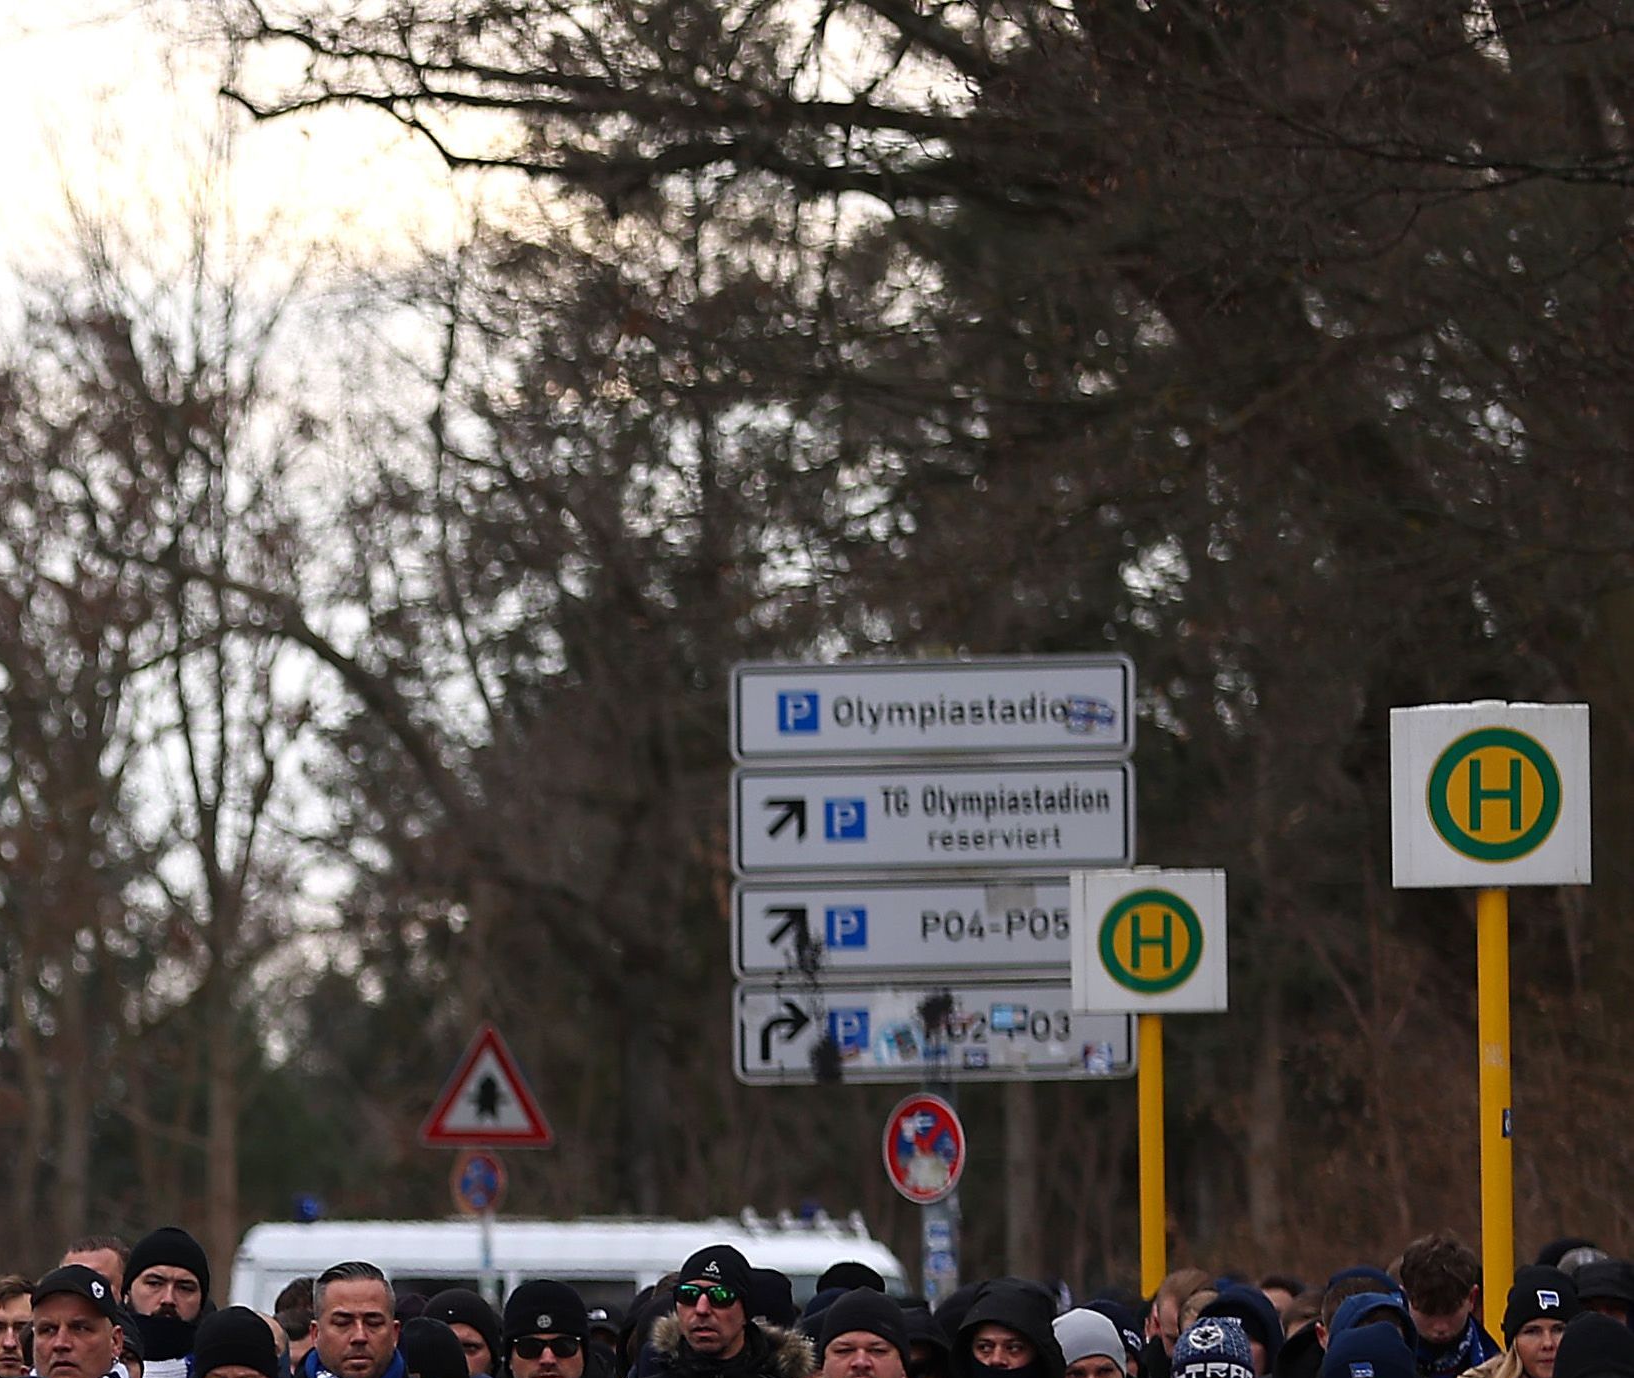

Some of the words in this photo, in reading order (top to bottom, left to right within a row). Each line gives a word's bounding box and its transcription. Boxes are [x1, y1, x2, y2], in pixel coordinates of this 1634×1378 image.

[786, 695, 811, 731] P
[832, 694, 1068, 735] Olympiastadio
[922, 783, 1110, 820] Olympiastadion
[1469, 758, 1522, 831] H
[927, 824, 1062, 851] reserviert
[920, 909, 1070, 941] P04-P05
[1131, 912, 1172, 970] H
